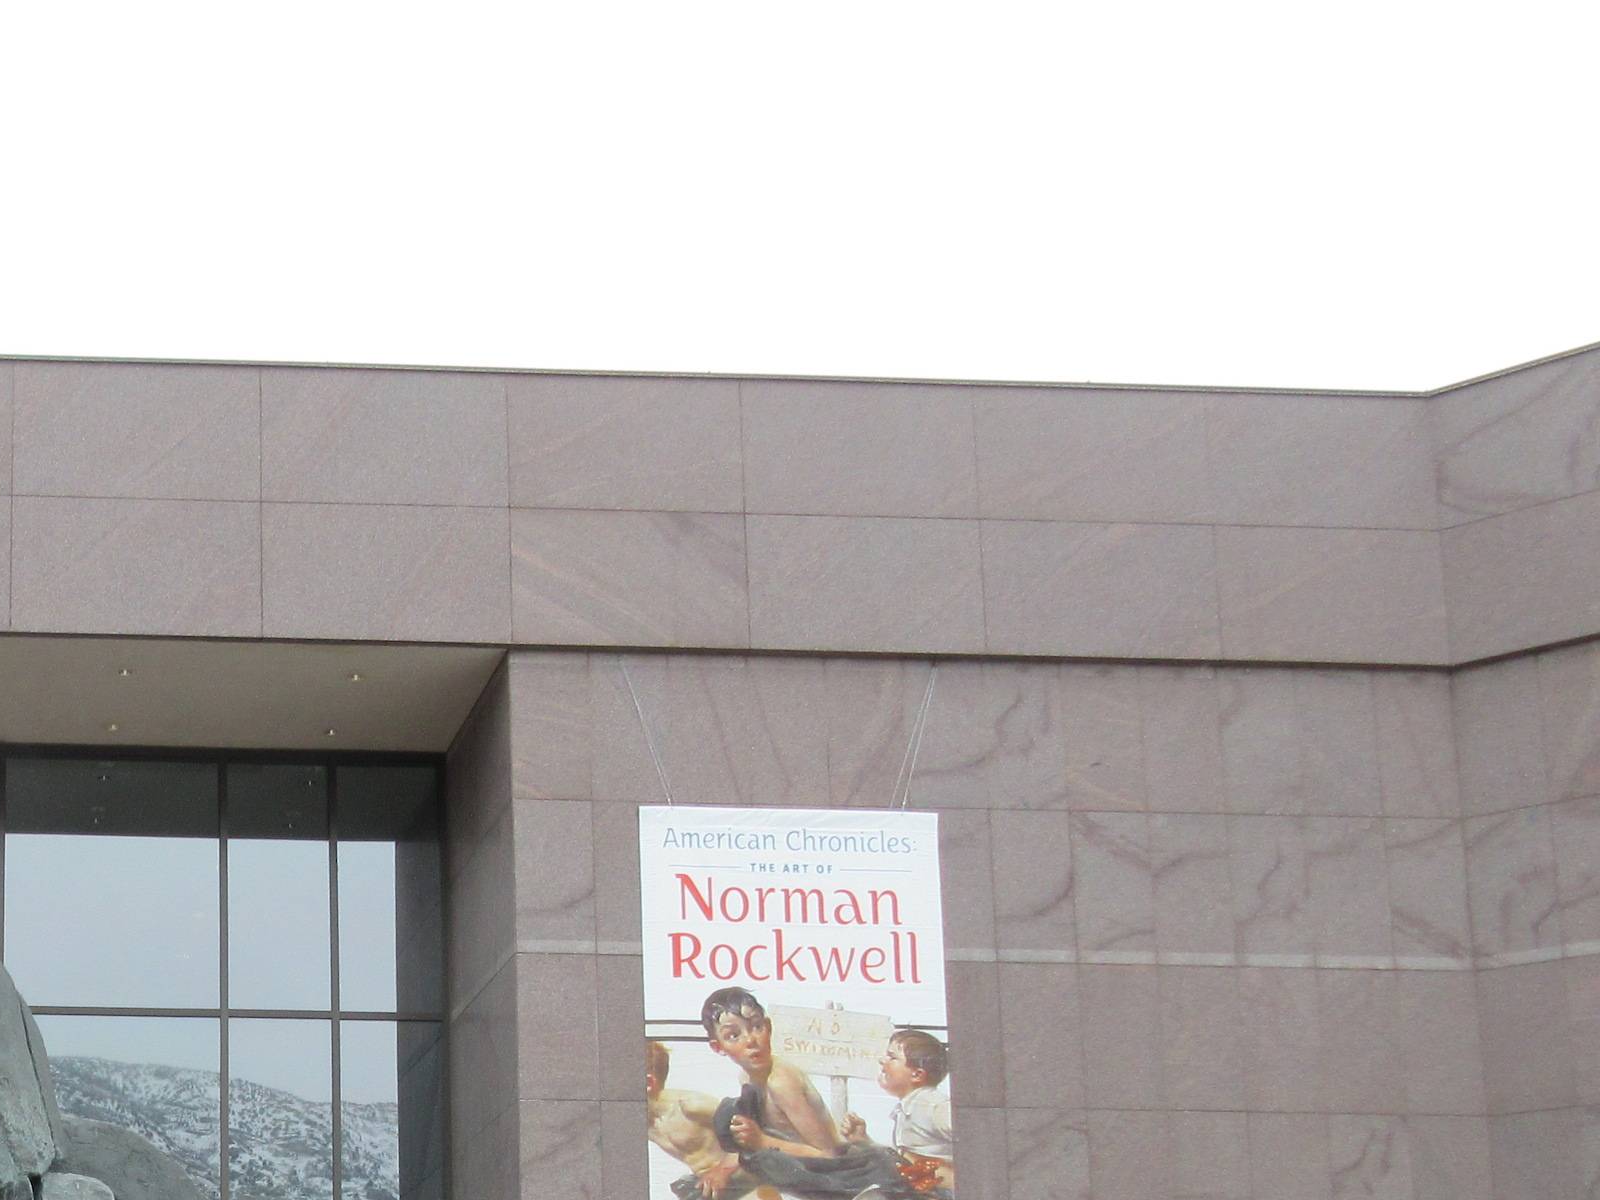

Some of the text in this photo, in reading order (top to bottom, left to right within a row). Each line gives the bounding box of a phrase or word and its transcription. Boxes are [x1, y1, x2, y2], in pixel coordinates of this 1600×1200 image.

[662, 827, 917, 854] American Chronicles:
[750, 863, 833, 874] THE ART OF
[674, 873, 903, 926] Norman
[667, 928, 923, 984] Rockwell
